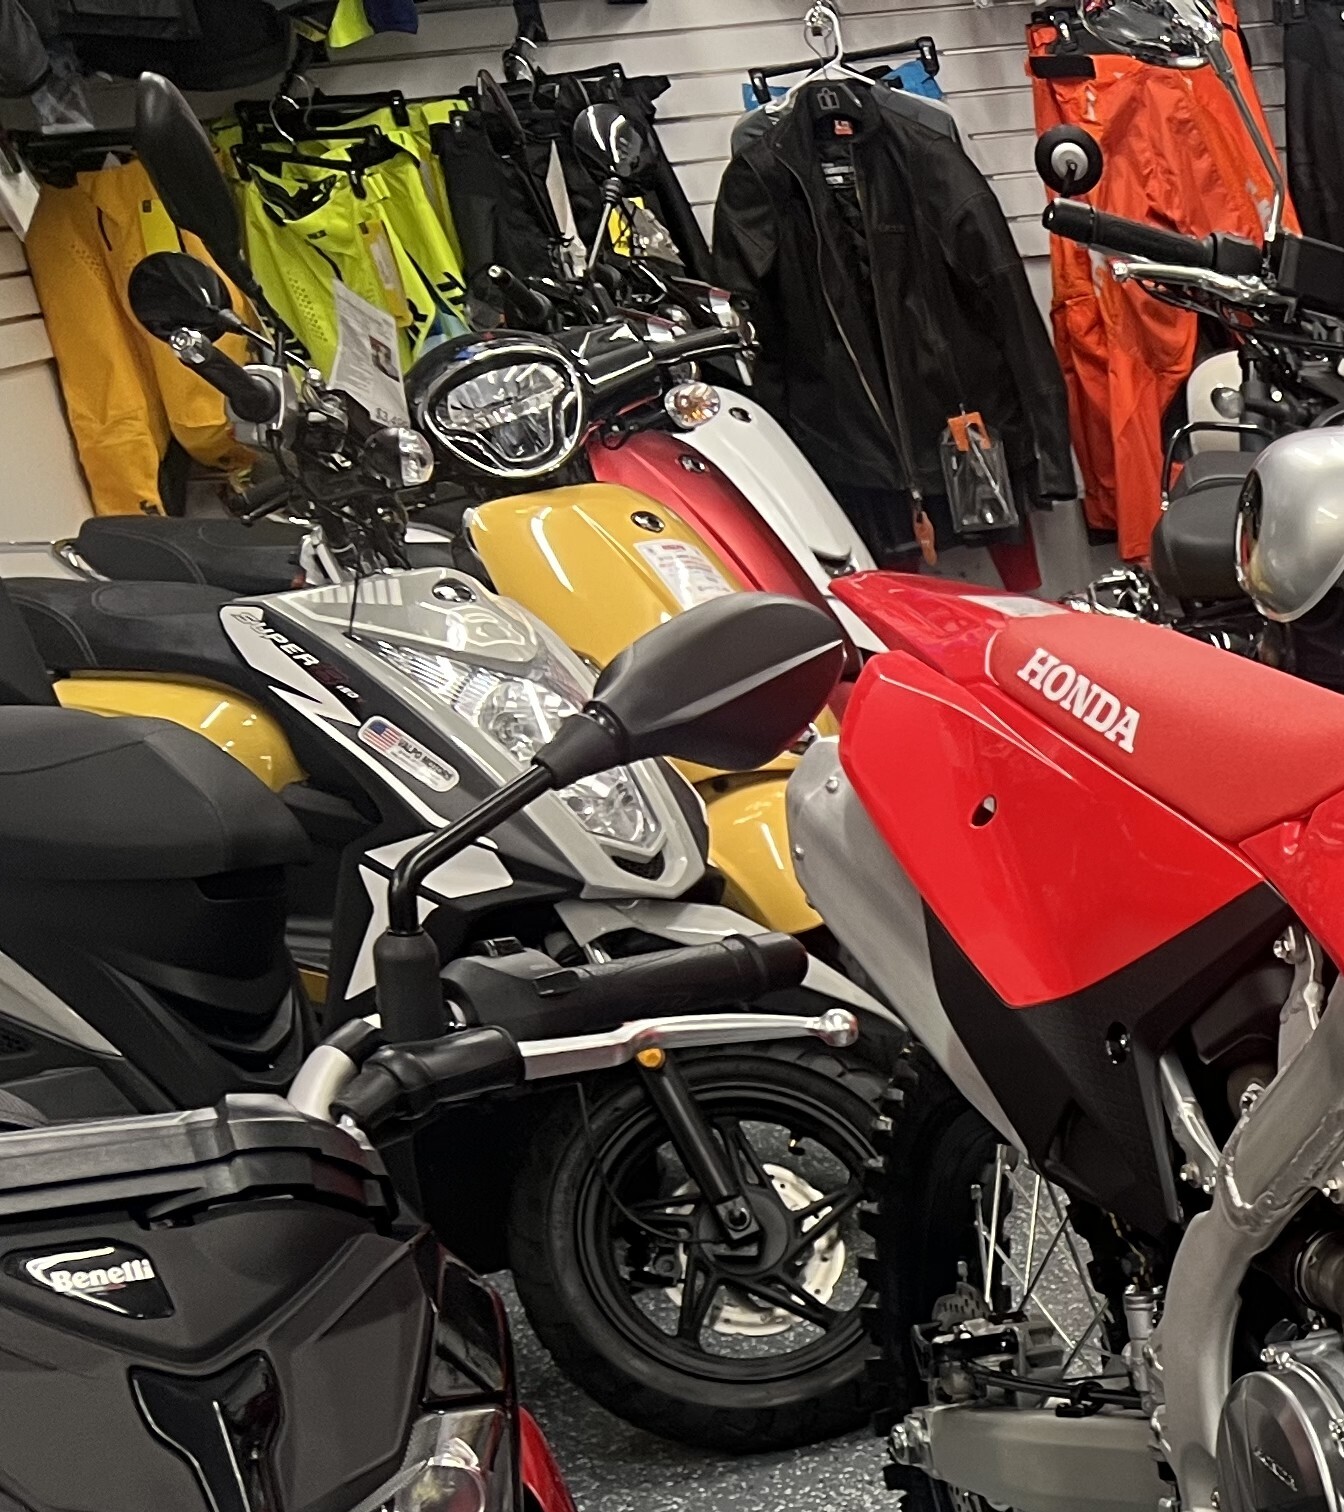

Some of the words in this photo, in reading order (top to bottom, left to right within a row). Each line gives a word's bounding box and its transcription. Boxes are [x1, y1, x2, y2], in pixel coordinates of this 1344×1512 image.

[231, 611, 320, 667] SUPER
[1016, 647, 1141, 754] HONDA
[50, 1258, 156, 1293] Benelli
